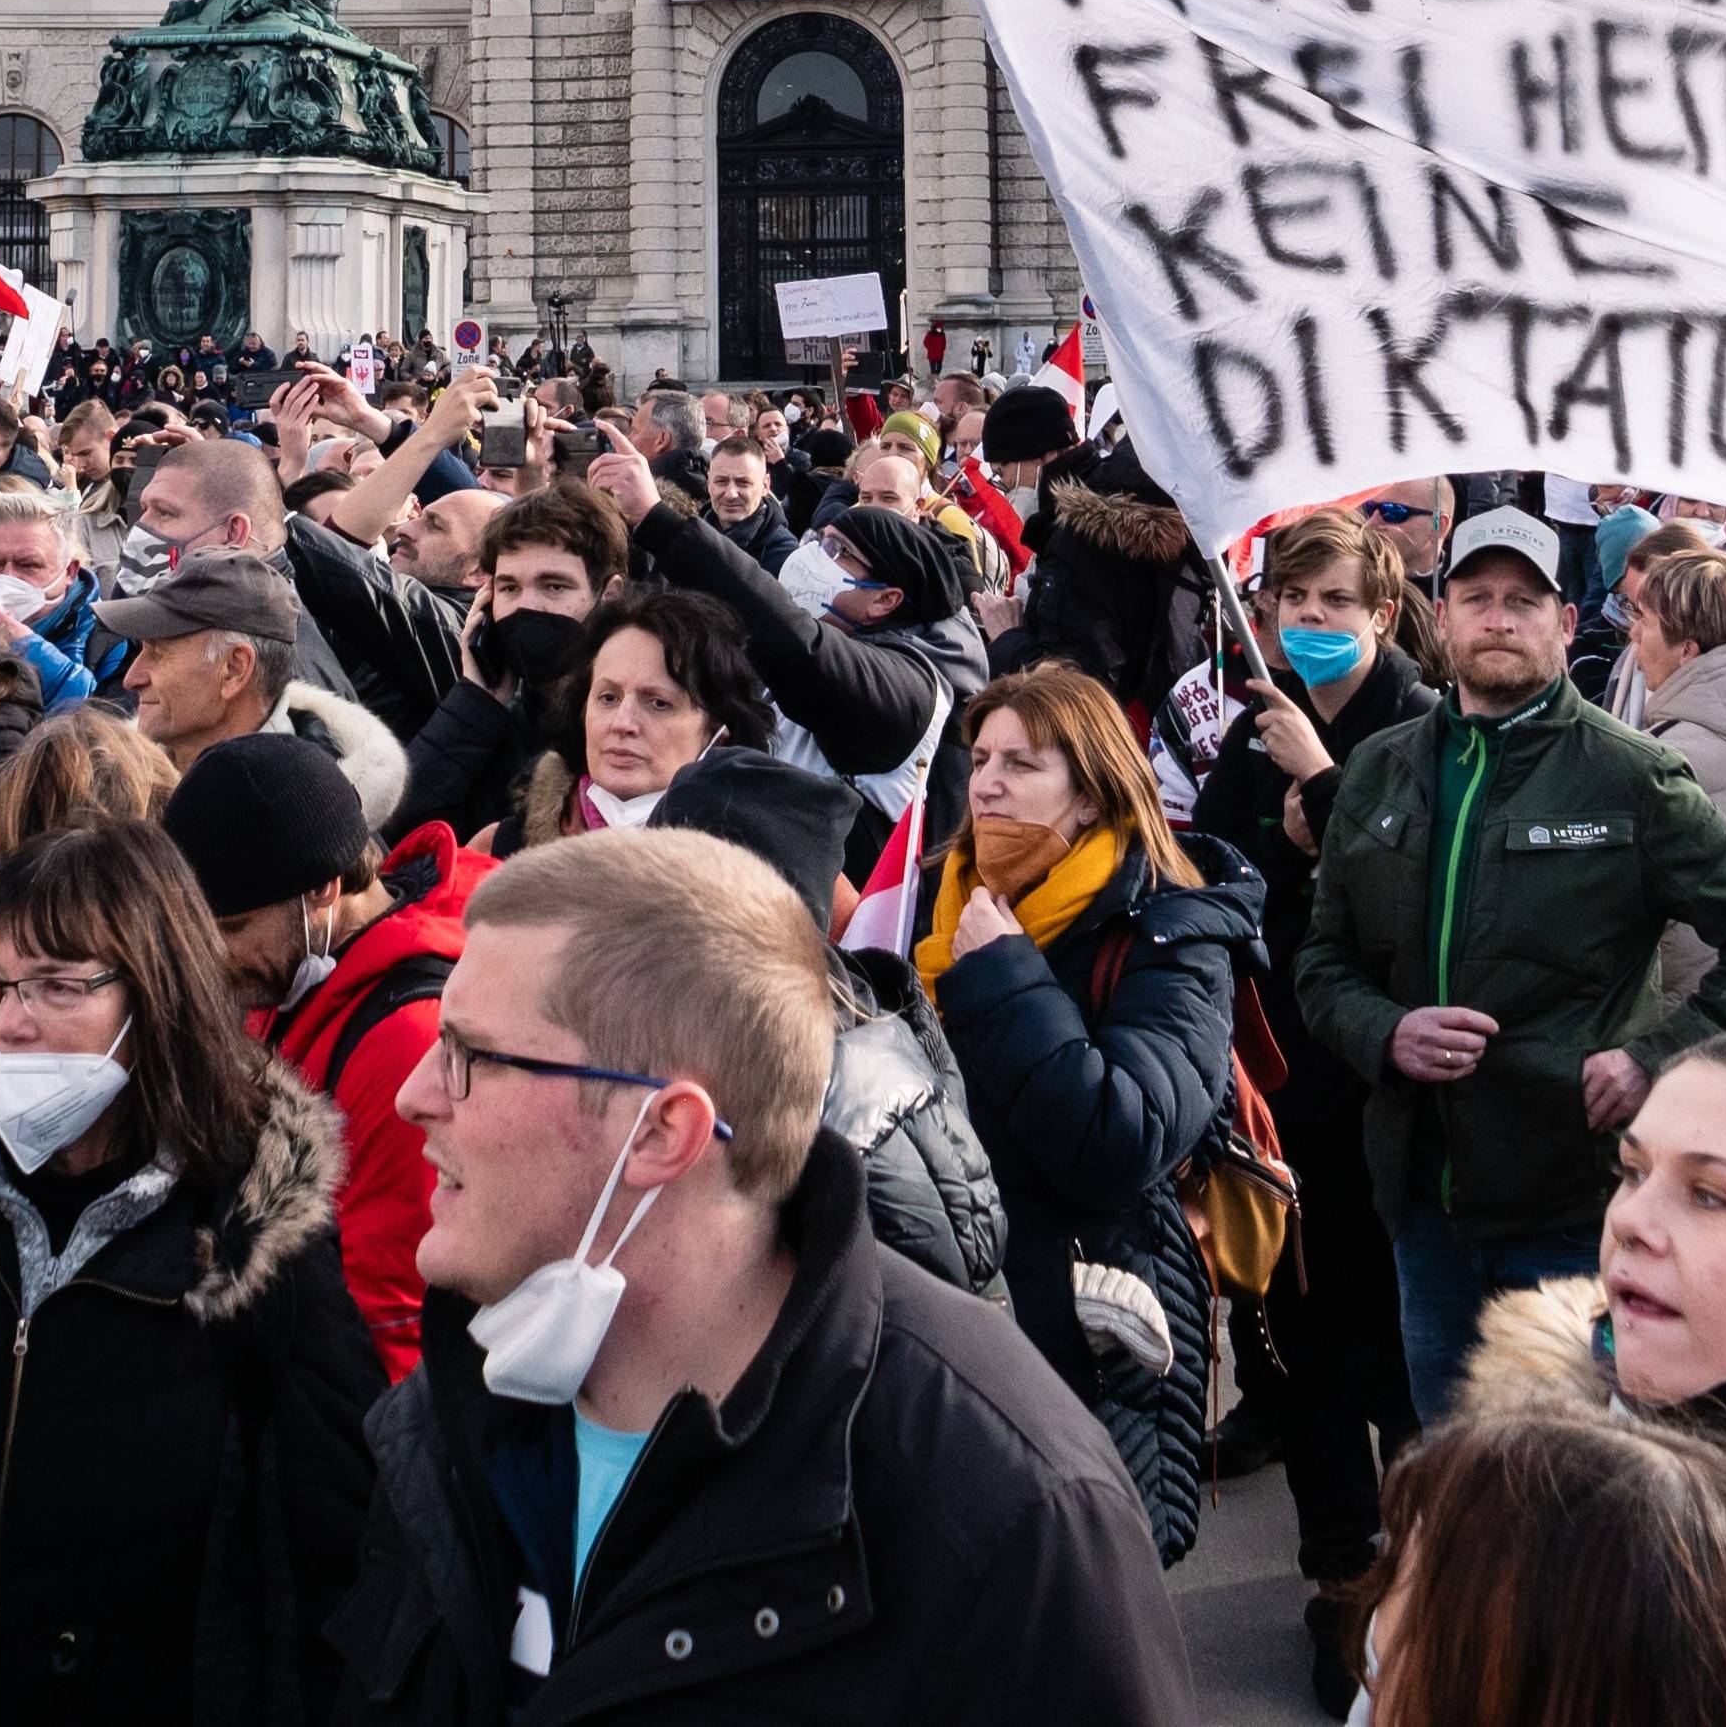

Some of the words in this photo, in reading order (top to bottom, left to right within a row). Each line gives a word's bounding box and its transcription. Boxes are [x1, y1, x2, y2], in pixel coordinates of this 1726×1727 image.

[1118, 157, 1670, 324] KEINE
[1086, 323, 1101, 336] Zo
[457, 352, 480, 363] Zone
